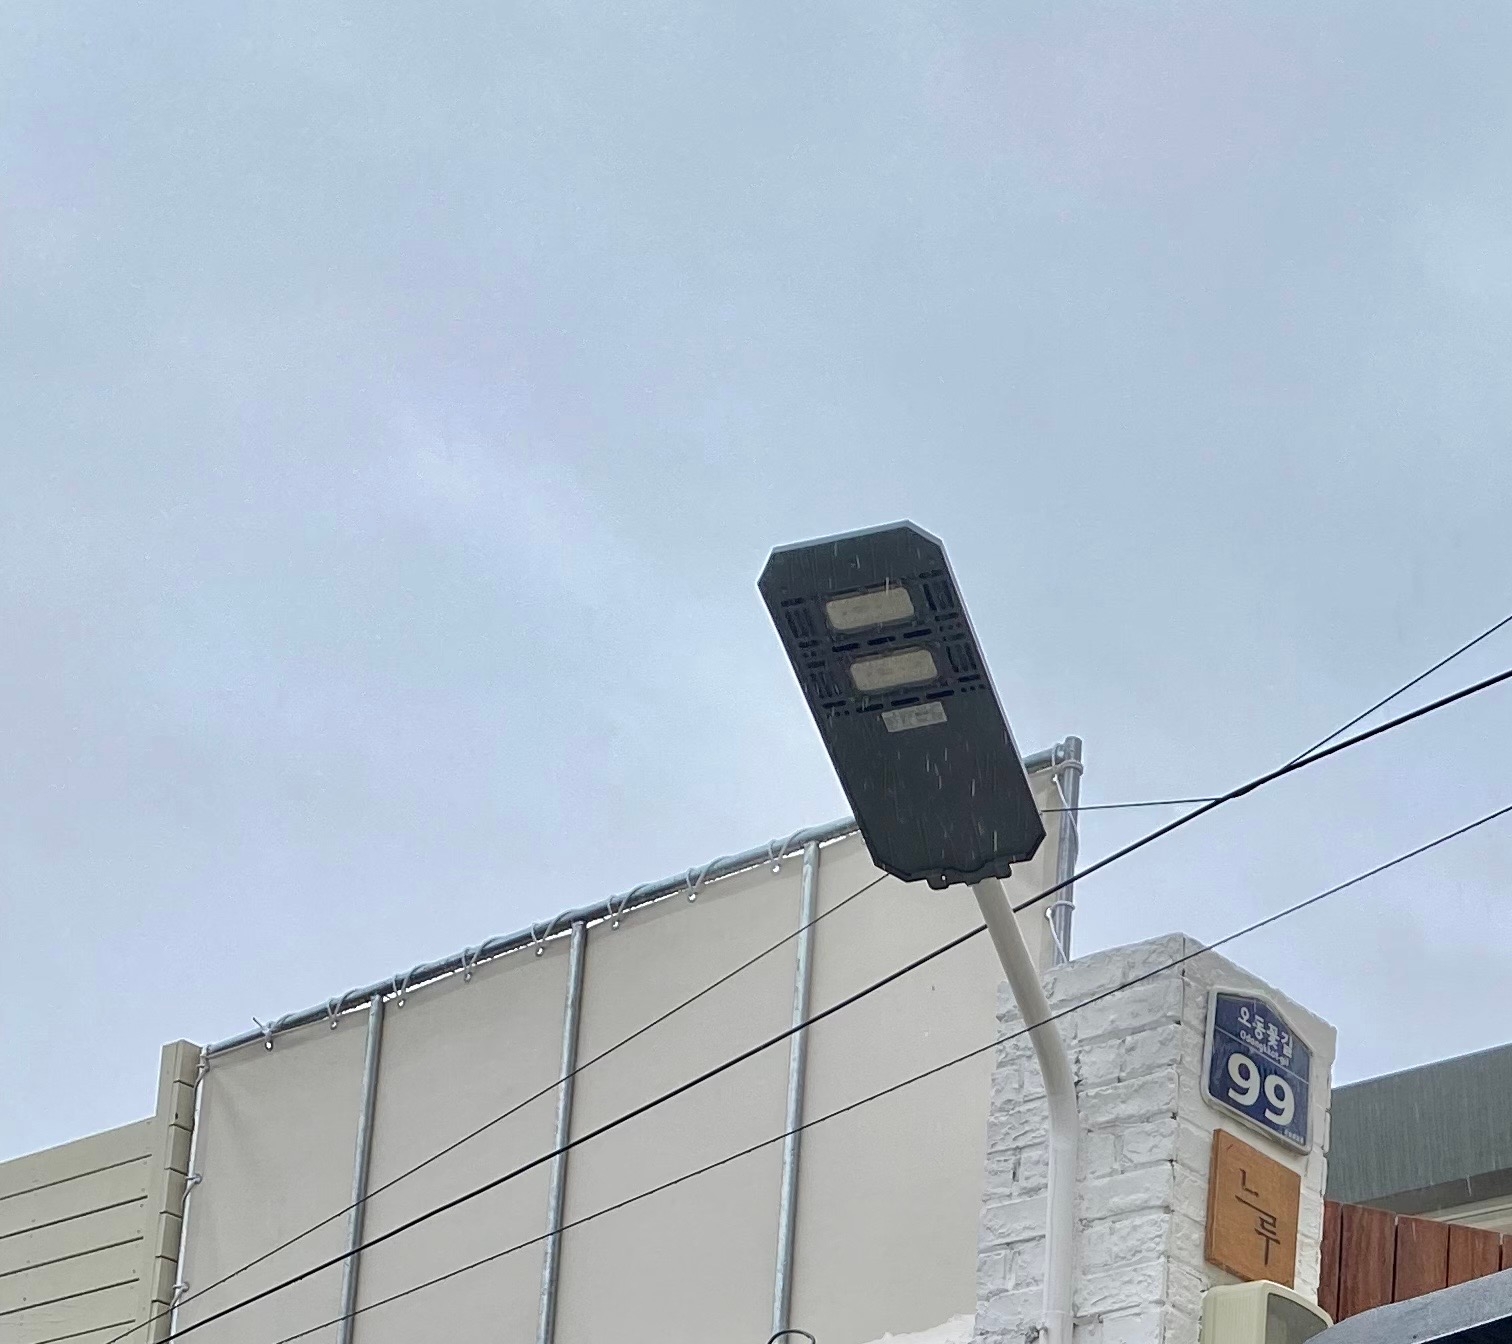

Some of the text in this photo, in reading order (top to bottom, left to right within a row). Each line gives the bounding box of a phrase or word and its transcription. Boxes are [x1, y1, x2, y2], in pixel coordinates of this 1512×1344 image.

[1238, 1007, 1293, 1058] 오동꽃길
[1227, 1052, 1296, 1126] 99
[1234, 1168, 1281, 1266] 느루
